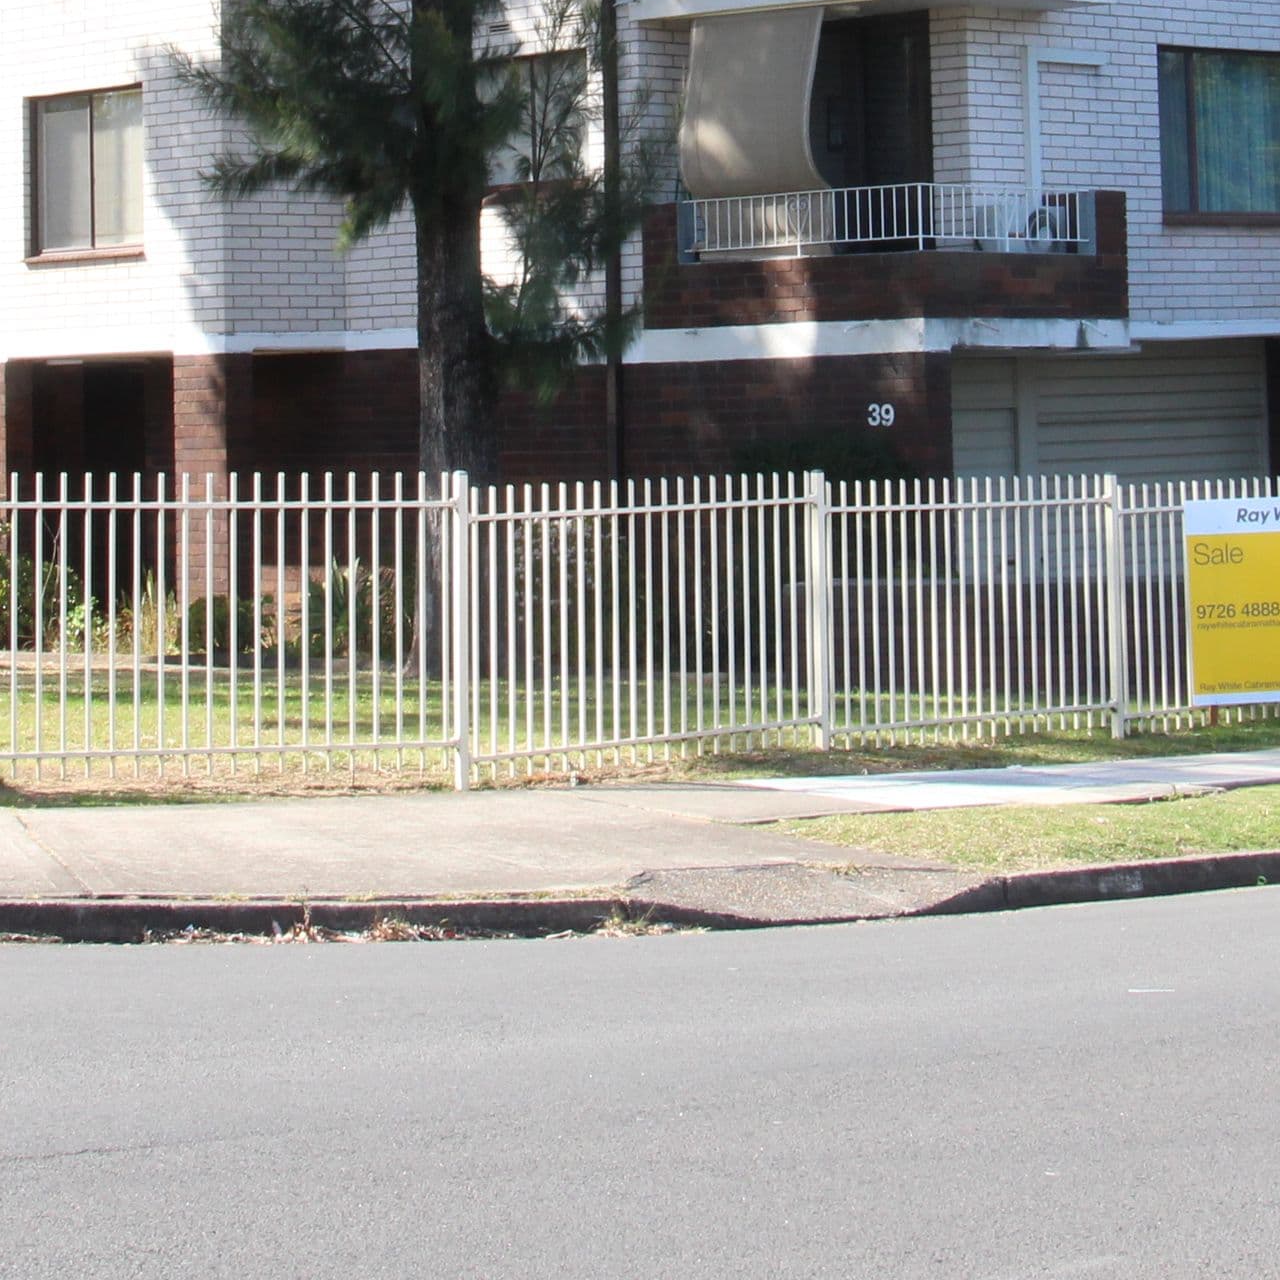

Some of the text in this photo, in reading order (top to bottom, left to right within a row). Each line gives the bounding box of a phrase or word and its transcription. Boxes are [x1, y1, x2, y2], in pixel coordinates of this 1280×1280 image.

[867, 403, 895, 427] 39
[1236, 507, 1271, 525] Ray
[1194, 542, 1244, 566] Sale
[1196, 602, 1280, 619] 9726 4888
[1199, 683, 1217, 692] Ray
[1218, 681, 1242, 690] White
